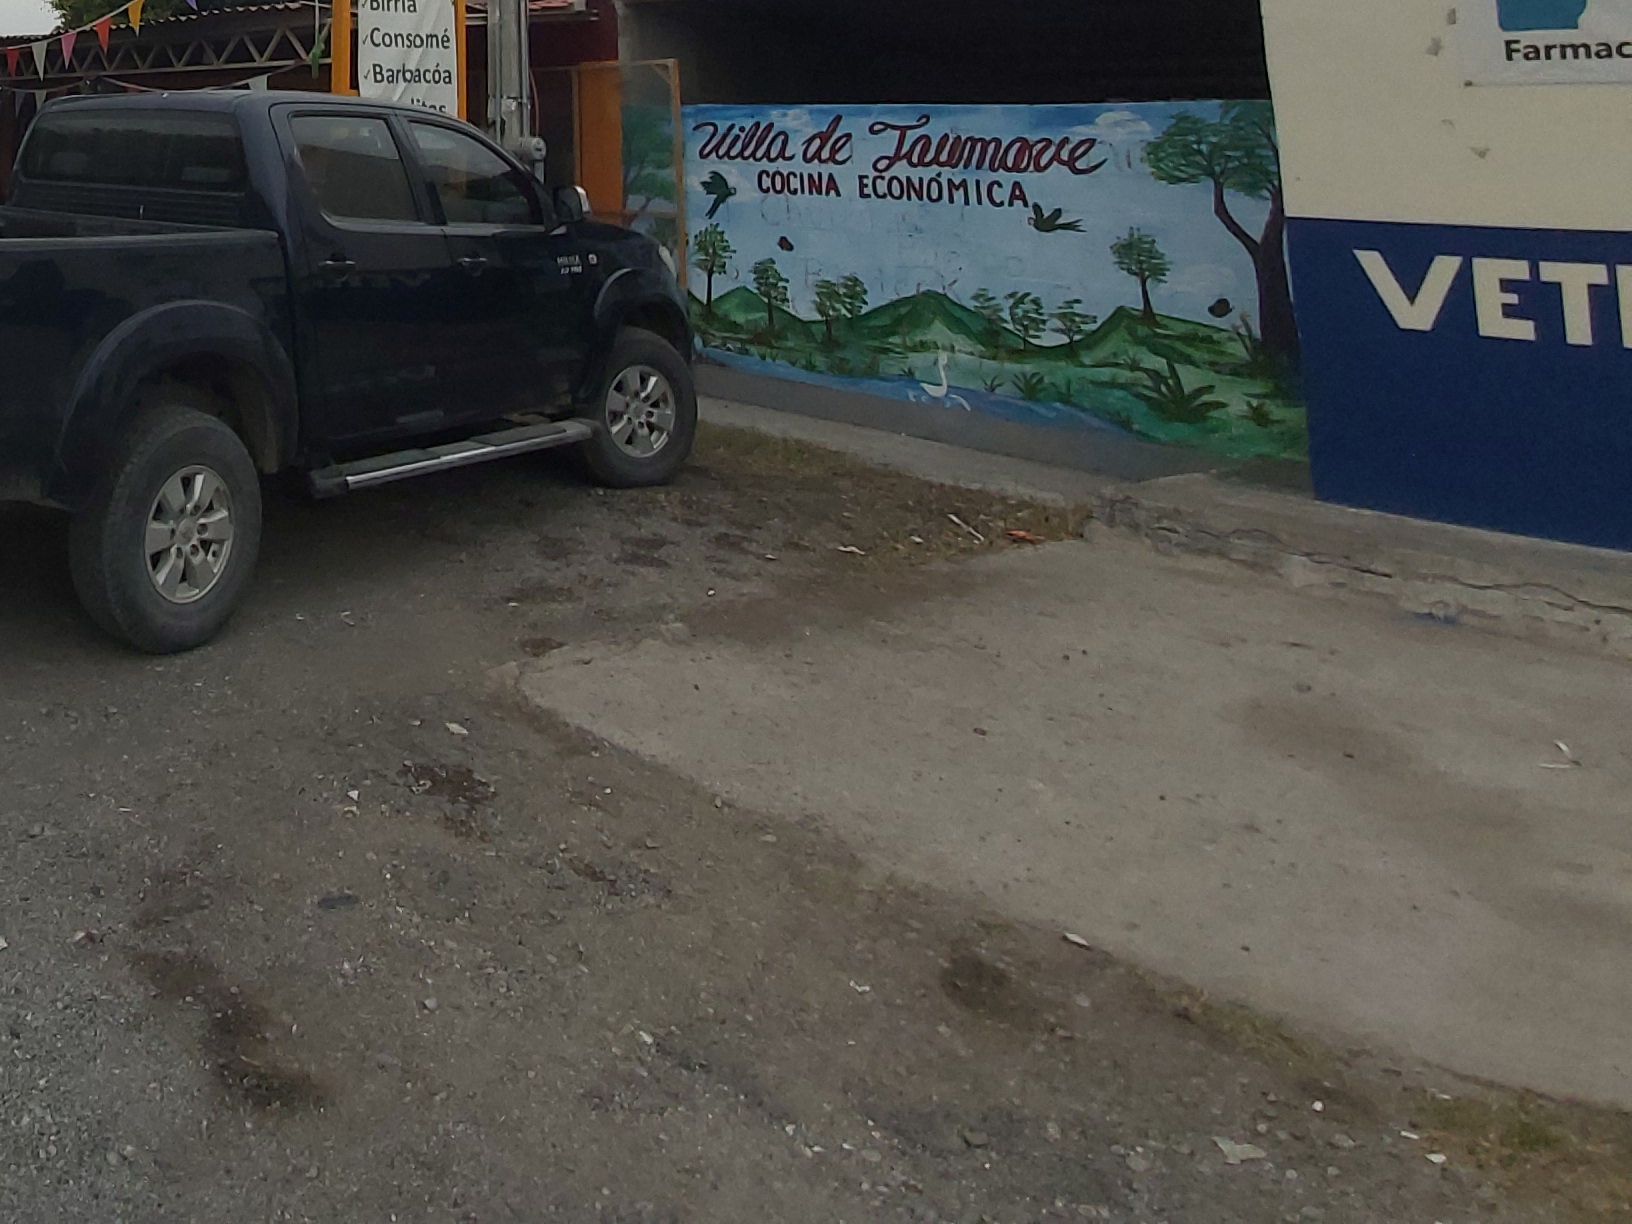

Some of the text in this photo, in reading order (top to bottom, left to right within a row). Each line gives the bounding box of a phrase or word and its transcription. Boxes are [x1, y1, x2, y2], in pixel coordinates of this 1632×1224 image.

[370, 27, 450, 49] Consomé
[372, 62, 452, 85] Barbacóa
[692, 121, 796, 163] Villa
[801, 114, 853, 166] de
[757, 169, 1029, 208] COCINA ECONÓMICA
[1352, 249, 1632, 349] VET
